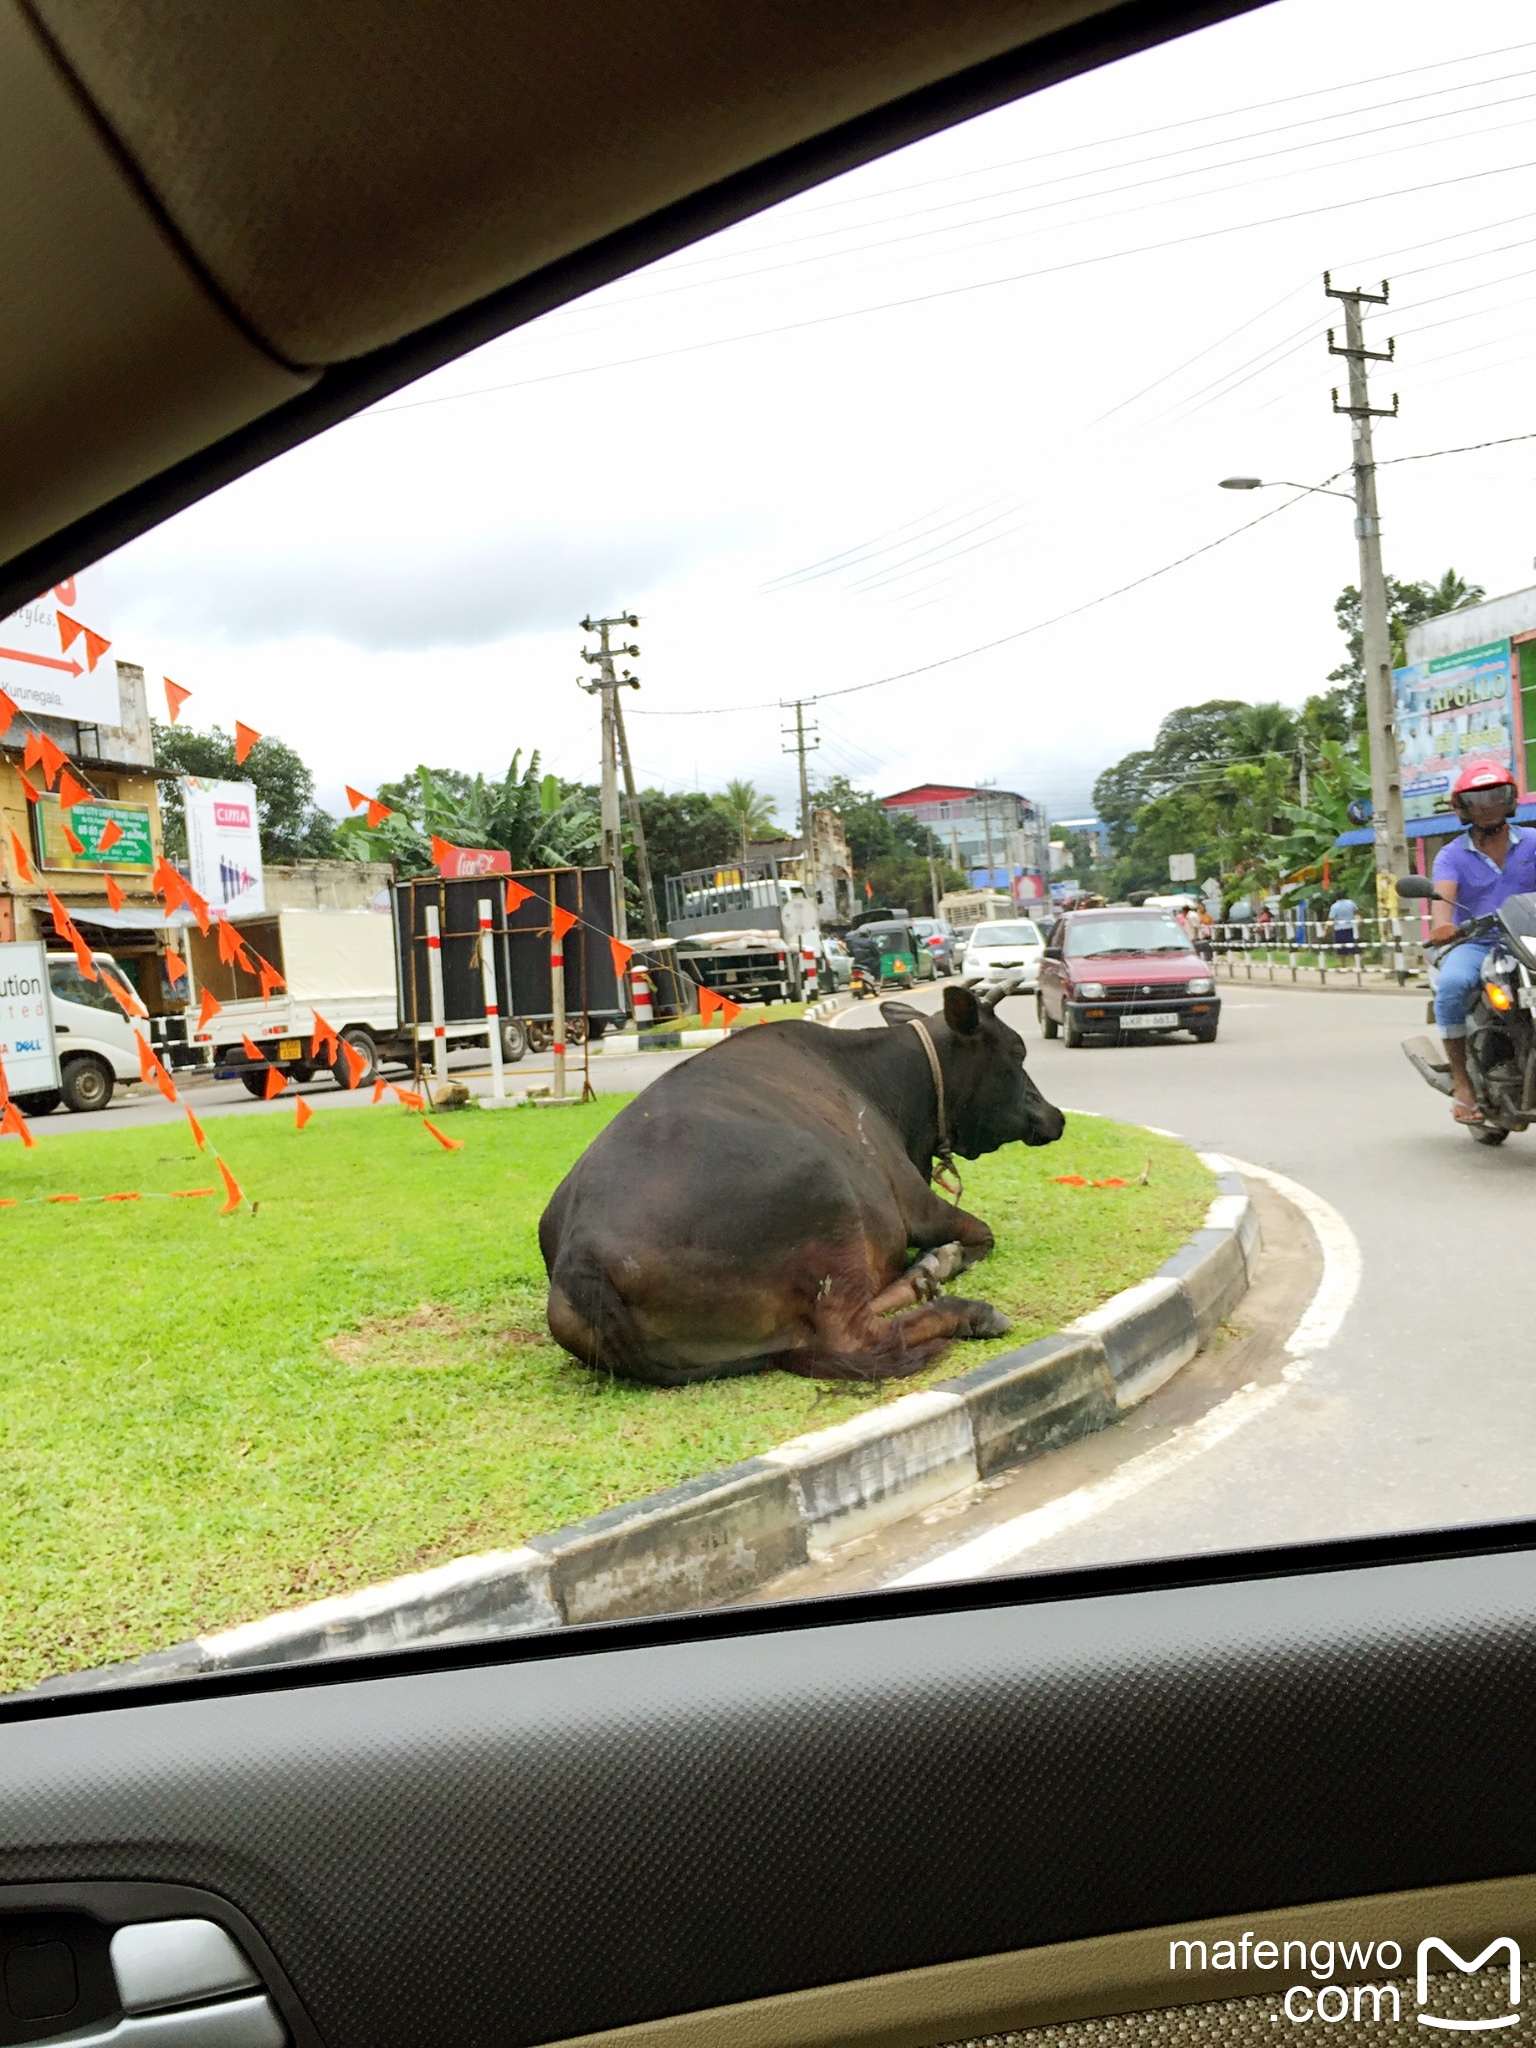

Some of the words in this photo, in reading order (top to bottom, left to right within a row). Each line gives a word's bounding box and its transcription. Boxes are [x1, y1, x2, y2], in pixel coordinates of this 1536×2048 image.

[1, 681, 65, 706] Kurunegala.
[1431, 673, 1508, 713] APOLLO
[216, 807, 249, 824] CIMA
[16, 1039, 42, 1053] DELL
